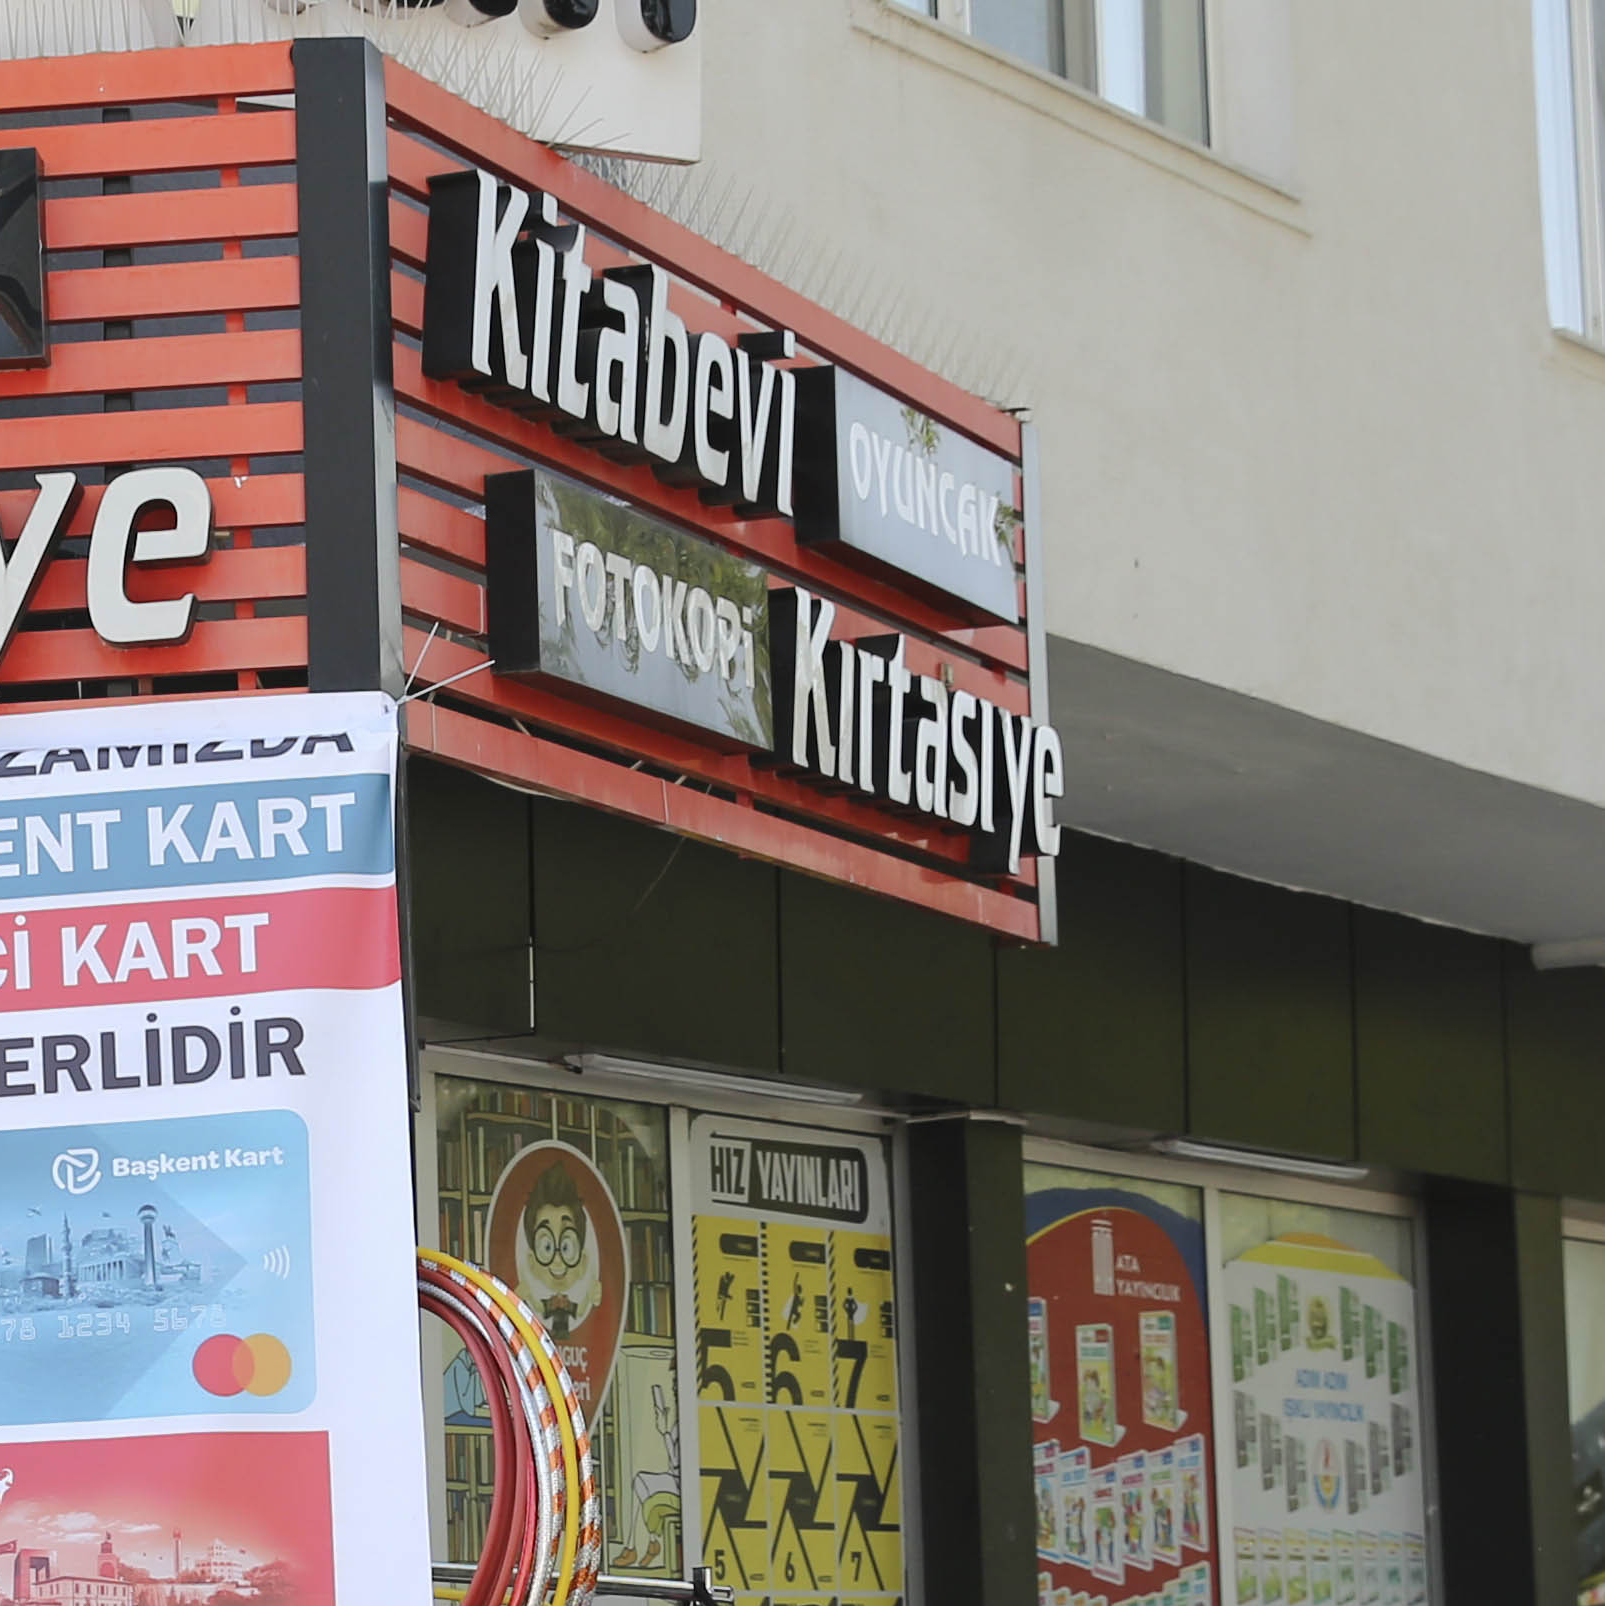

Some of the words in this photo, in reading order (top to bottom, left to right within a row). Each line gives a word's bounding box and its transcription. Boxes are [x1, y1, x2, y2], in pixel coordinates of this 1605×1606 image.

[472, 169, 794, 517] Kitabevi
[849, 422, 1002, 567] OYUNCAK
[147, 791, 356, 867] KART
[61, 912, 270, 988] KART
[111, 1152, 221, 1183] Başkent
[224, 1145, 284, 1169] Kart
[710, 1145, 748, 1198] HIZ
[757, 1149, 860, 1211] YAYINLARI
[57, 1312, 131, 1339] 1234
[714, 1550, 725, 1580] 5
[784, 1552, 795, 1582] 6
[851, 1553, 863, 1582] 7
